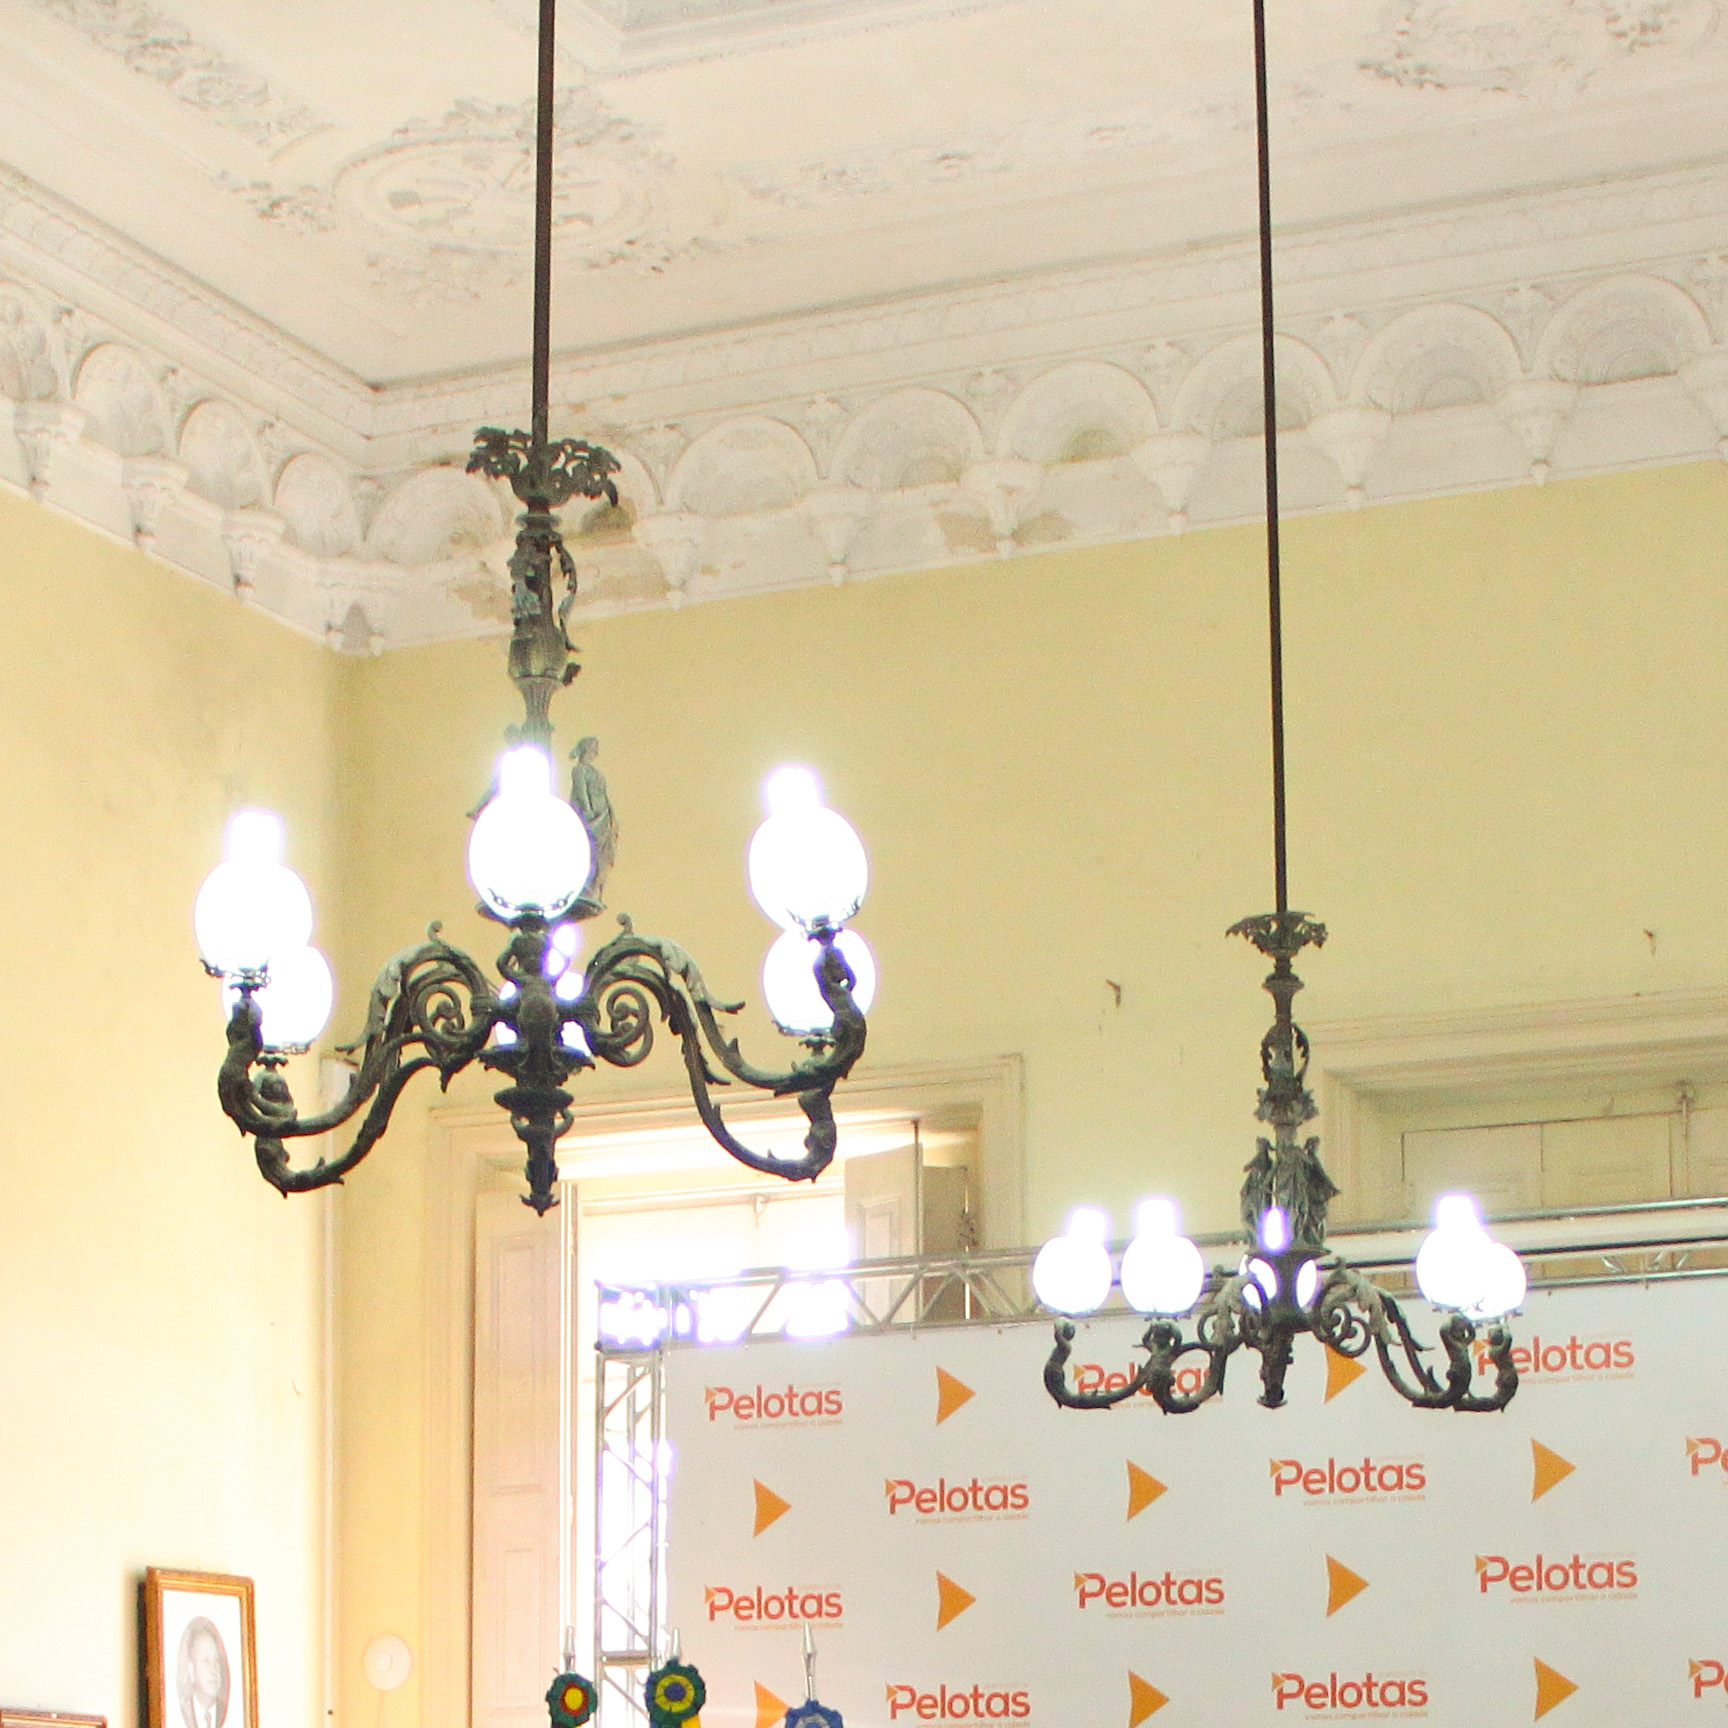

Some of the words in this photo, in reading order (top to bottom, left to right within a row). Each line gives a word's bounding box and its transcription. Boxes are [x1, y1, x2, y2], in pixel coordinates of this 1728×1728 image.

[705, 1384, 844, 1421] Pelotas
[885, 1477, 1030, 1515] Pelotas
[1271, 1458, 1427, 1496] Pelotas
[1075, 1571, 1225, 1609] Pelotas
[1475, 1554, 1639, 1594] Pelotas
[704, 1586, 844, 1623] Pelotas
[885, 1683, 1031, 1721] Pelotas
[1271, 1671, 1429, 1711] Pelotas
